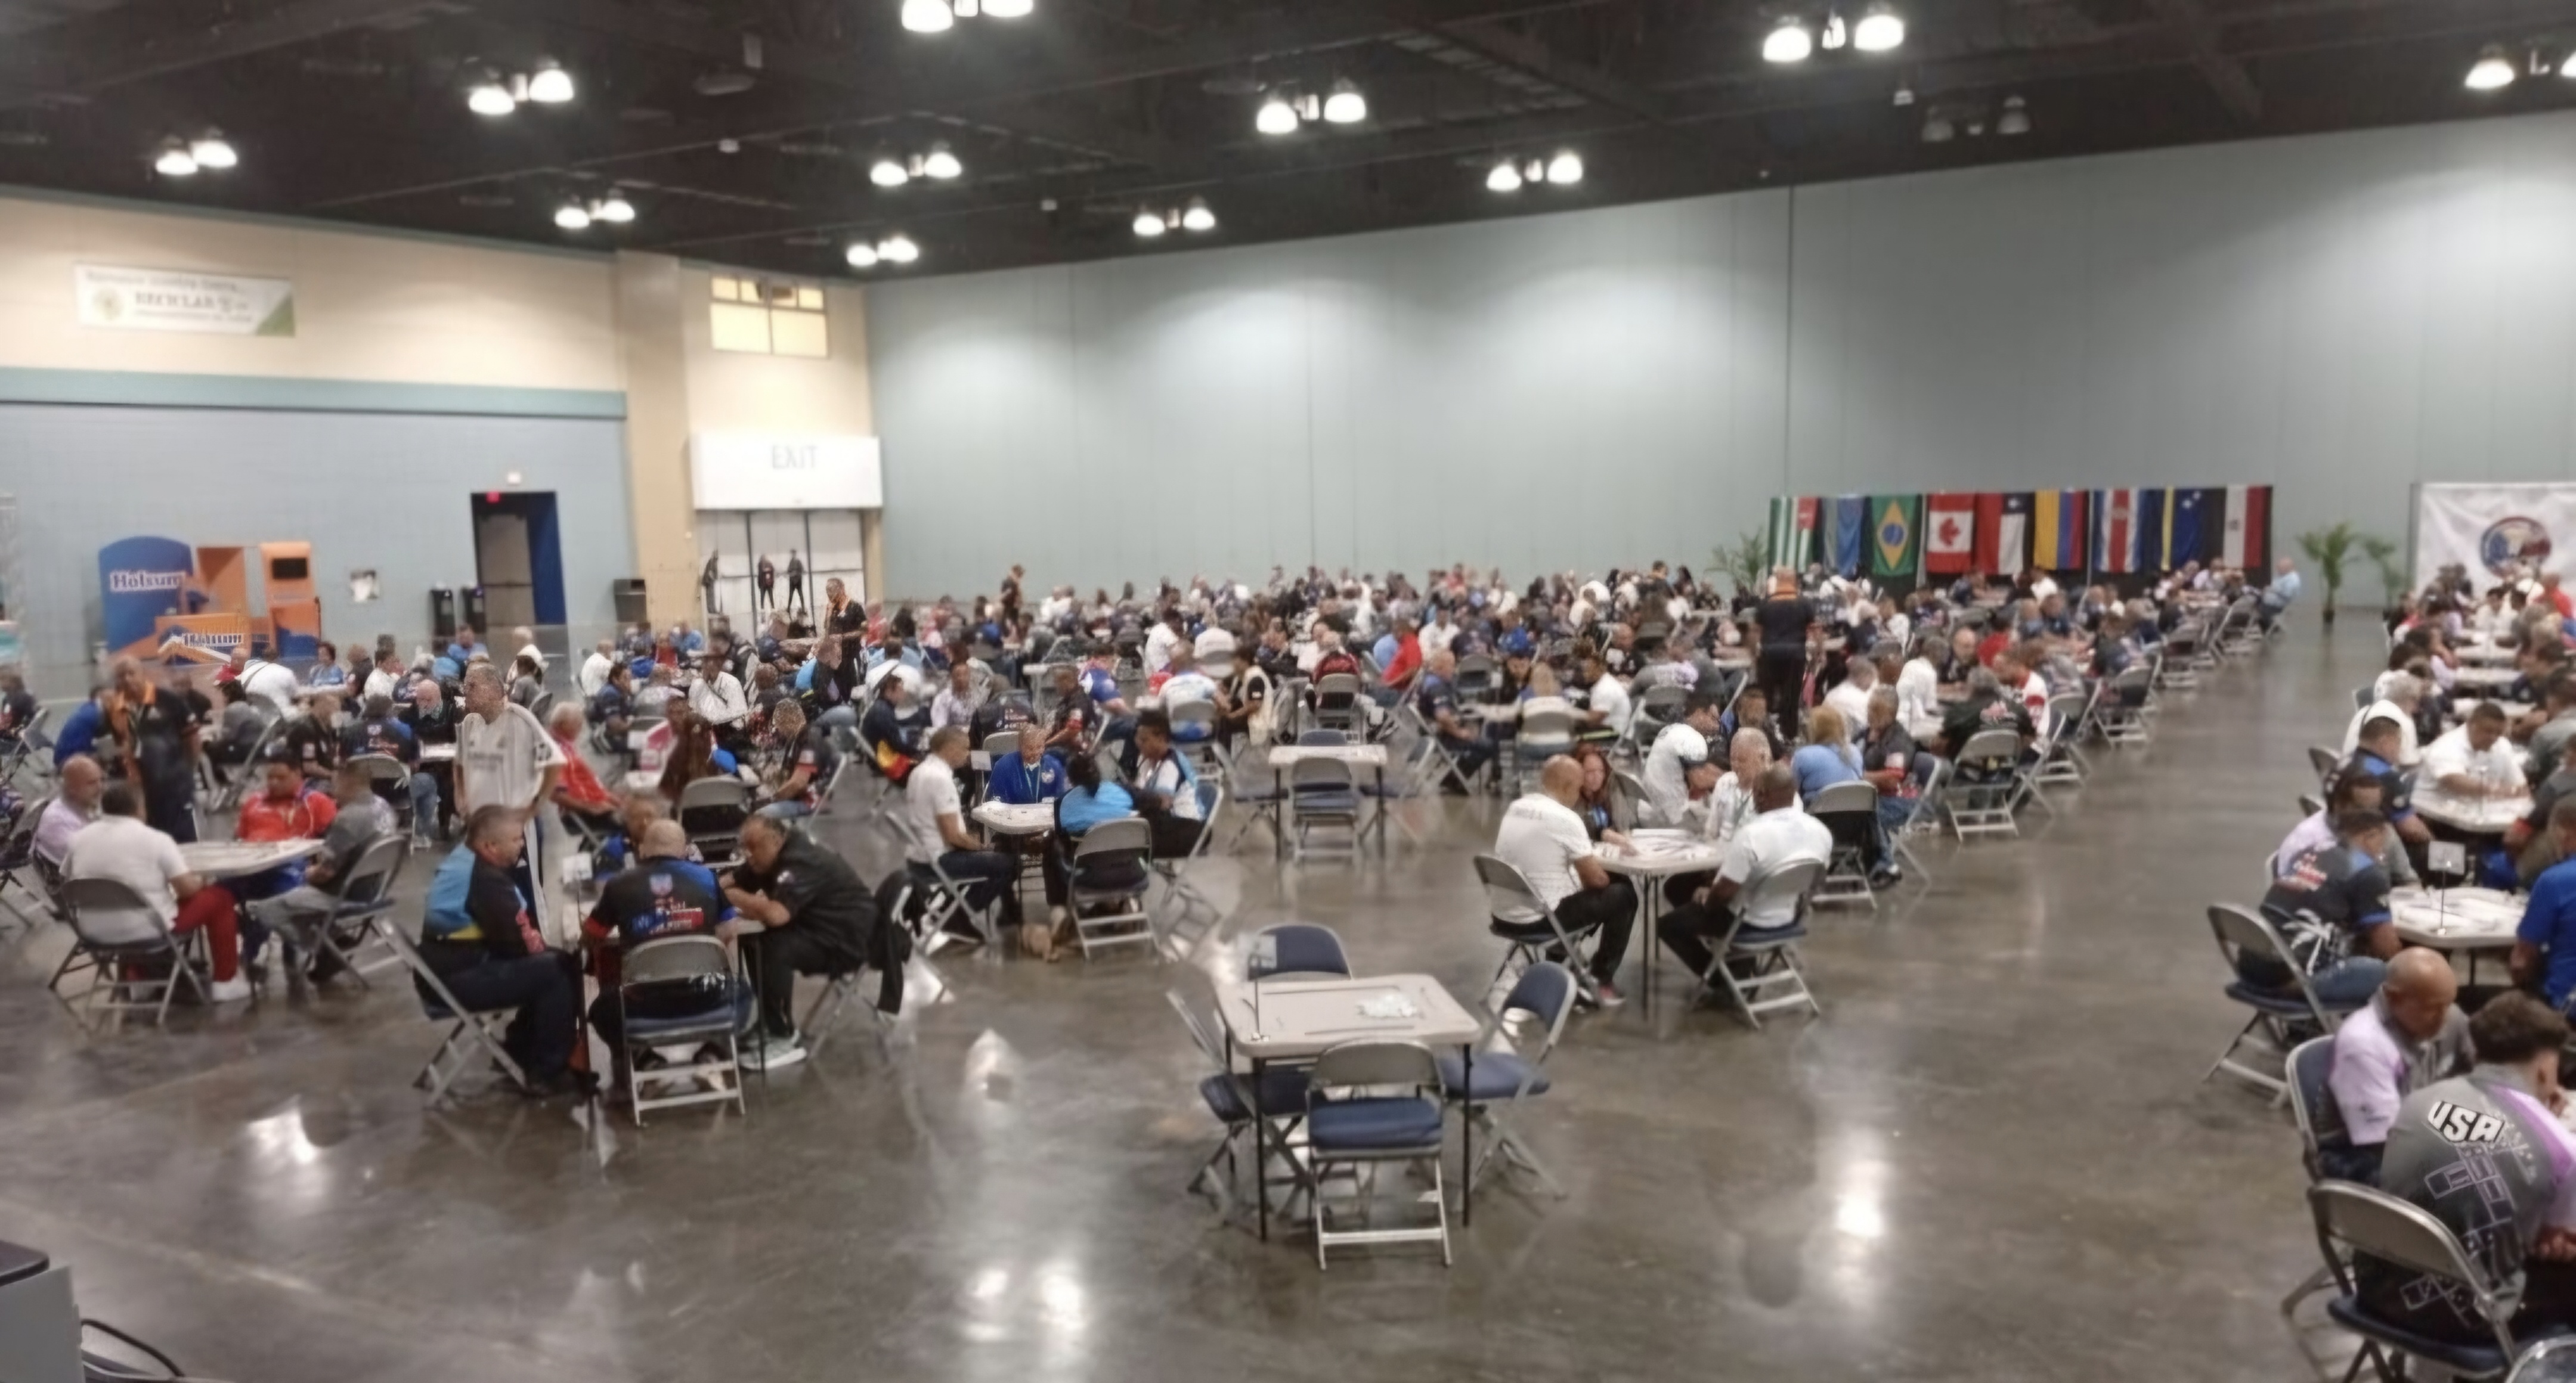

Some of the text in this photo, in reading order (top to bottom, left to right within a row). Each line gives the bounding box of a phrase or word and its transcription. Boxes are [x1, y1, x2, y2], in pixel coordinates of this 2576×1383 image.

[772, 445, 819, 469] EXIT
[112, 572, 181, 589] Holsum
[2428, 1100, 2505, 1143] USA
